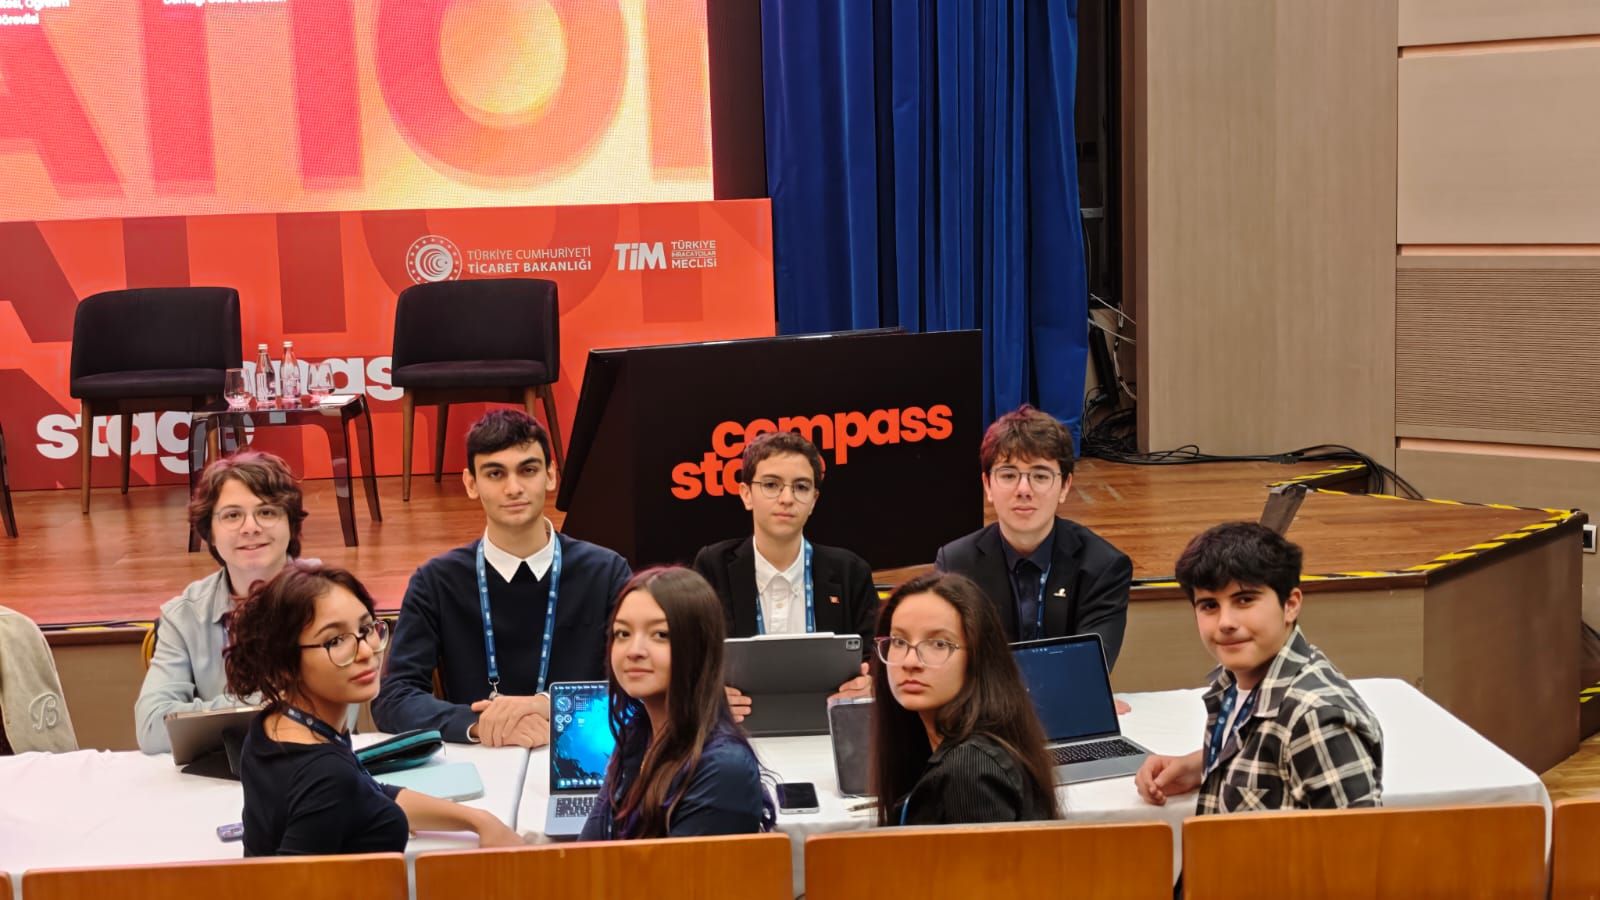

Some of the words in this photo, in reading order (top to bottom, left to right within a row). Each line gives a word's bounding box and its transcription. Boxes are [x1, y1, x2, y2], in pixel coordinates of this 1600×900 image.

[467, 248, 513, 261] TÜRKİYE
[515, 246, 591, 260] CUMHURİYETİ
[467, 262, 520, 274] TİCARET
[523, 259, 591, 273] BAKANLIĞI
